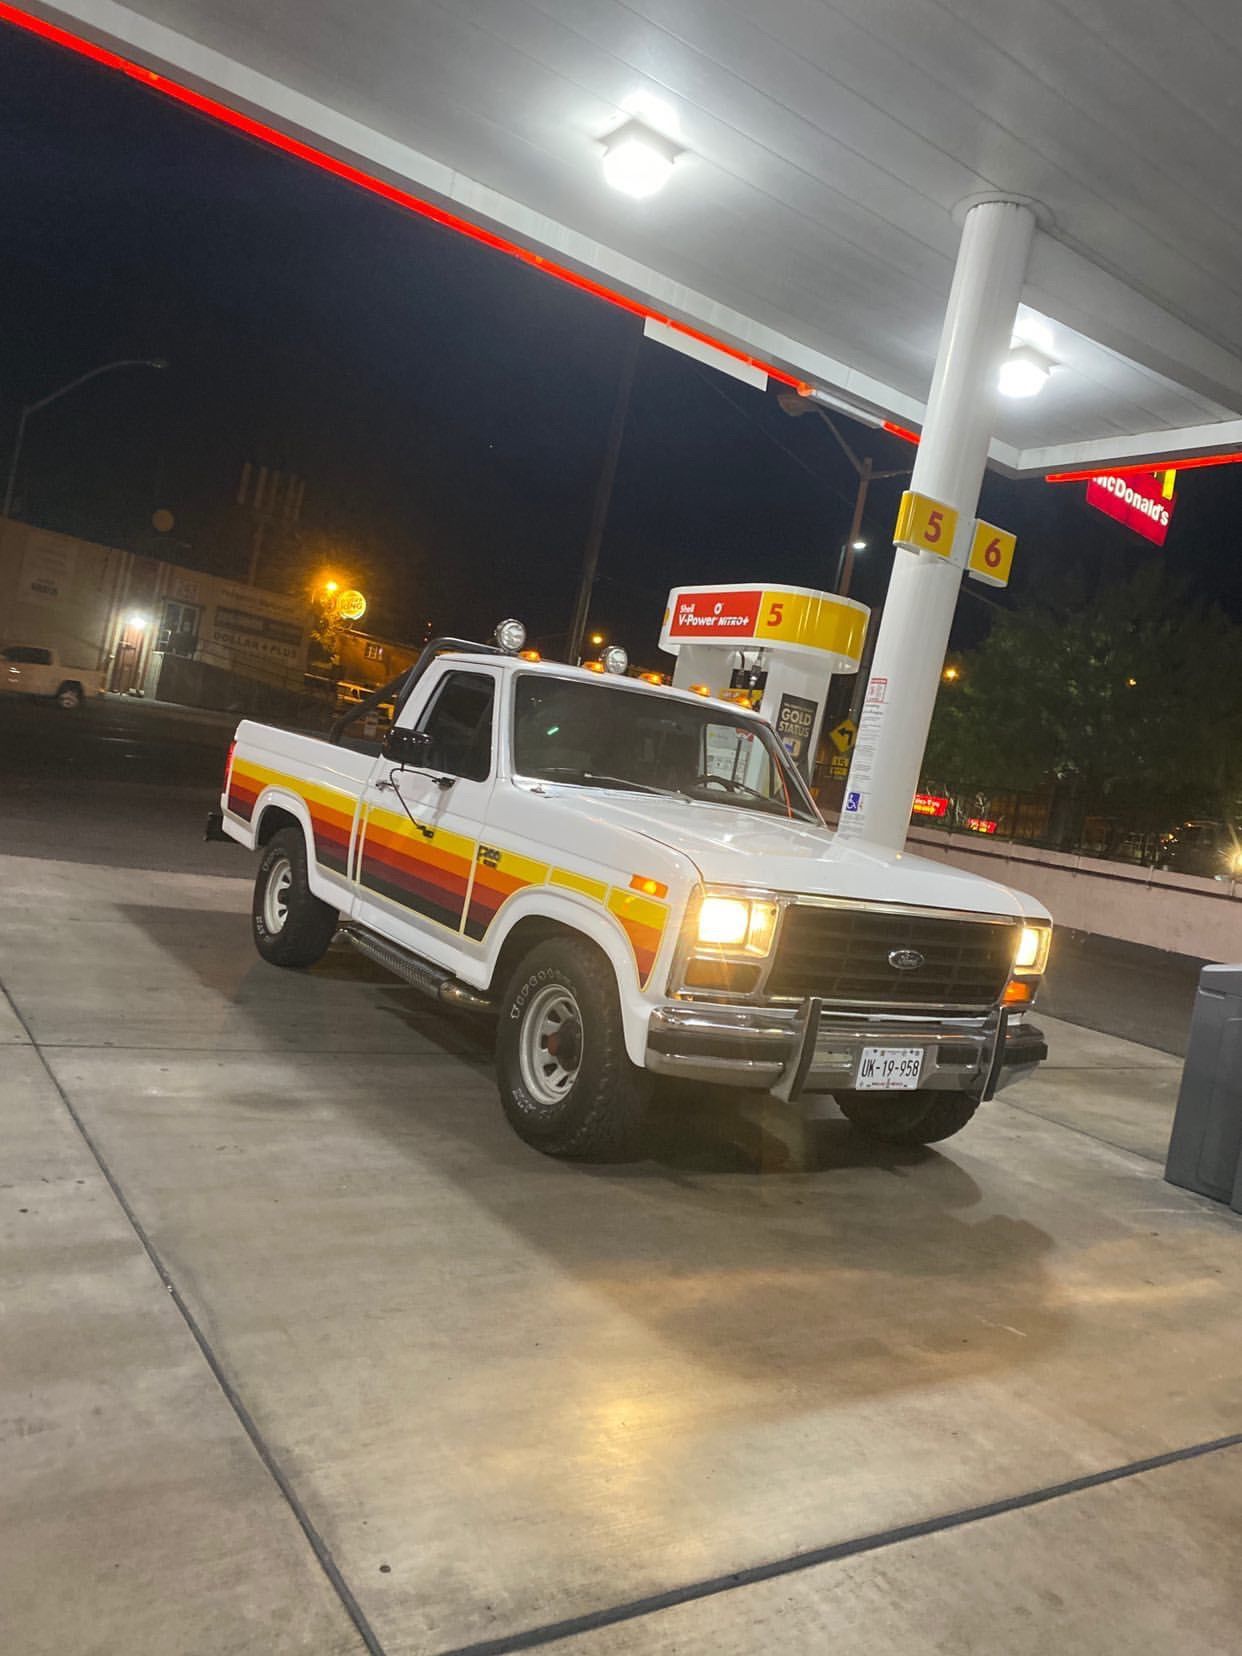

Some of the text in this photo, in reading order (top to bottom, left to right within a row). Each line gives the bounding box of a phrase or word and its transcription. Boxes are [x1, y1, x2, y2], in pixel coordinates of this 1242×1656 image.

[923, 510, 944, 543] 5
[984, 537, 1001, 568] 6
[680, 603, 696, 613] Shell
[767, 602, 784, 627] 5
[678, 613, 718, 626] V-Power
[781, 707, 812, 726] GOLD
[778, 721, 810, 737] STATUS
[861, 1058, 920, 1078] UK-19-958
